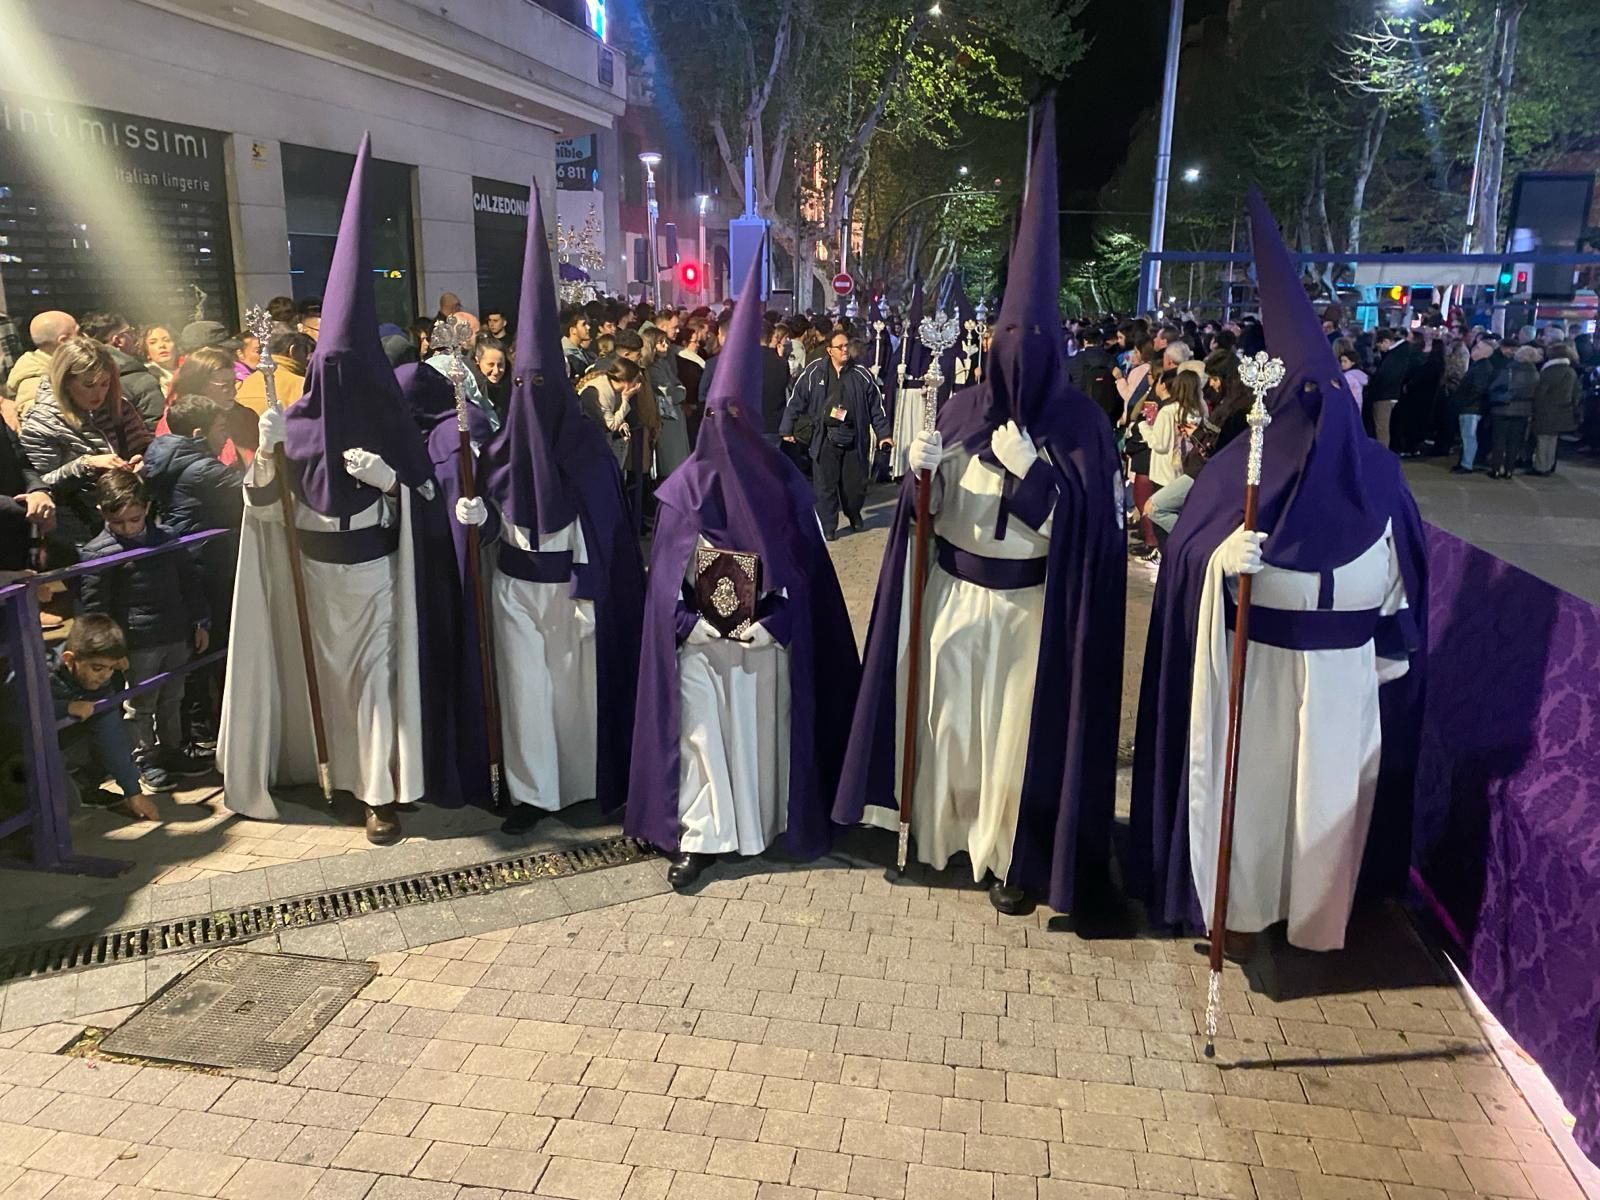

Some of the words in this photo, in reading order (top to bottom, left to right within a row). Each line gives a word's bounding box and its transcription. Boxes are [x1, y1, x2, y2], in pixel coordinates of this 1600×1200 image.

[4, 104, 208, 159] intimissimi
[115, 165, 158, 186] Italian
[163, 173, 210, 193] lingerie
[567, 166, 586, 180] 811
[473, 191, 529, 216] CALZEDONIA
